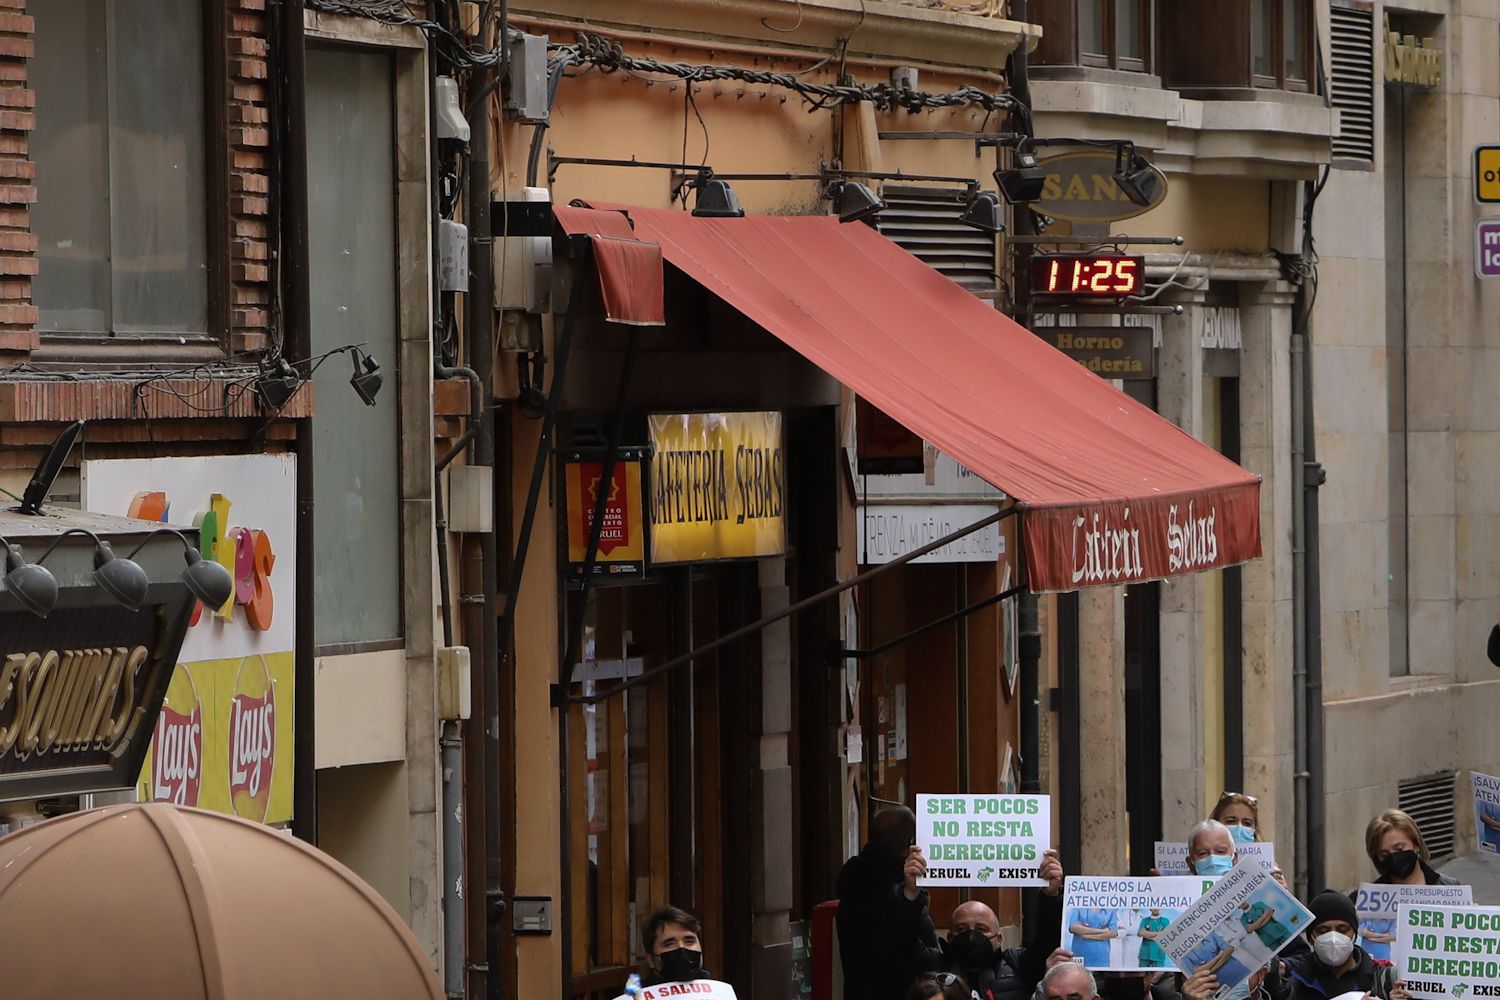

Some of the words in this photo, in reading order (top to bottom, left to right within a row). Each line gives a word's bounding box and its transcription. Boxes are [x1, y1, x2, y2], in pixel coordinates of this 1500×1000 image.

[1049, 260, 1136, 291] 11:25
[1057, 334, 1124, 349] Horno
[736, 445, 782, 524] SEBAS
[232, 691, 272, 798] Lay's
[927, 799, 967, 815] SER
[974, 799, 1039, 815] POCOS
[933, 821, 960, 837] NO
[967, 821, 1033, 837] RESTA
[930, 844, 1036, 861] DERECHOS
[1068, 880, 1133, 893] ¡SALVEMOS
[1138, 880, 1153, 892] LA
[1067, 894, 1128, 907] ATENCIÓN
[1131, 896, 1191, 908] PRIMARIA!
[1357, 891, 1398, 912] 25%
[1400, 887, 1411, 897] DEL
[1412, 887, 1463, 897] PRESUPUESTO
[1408, 909, 1445, 929] SER
[1412, 933, 1437, 951] NO
[658, 982, 712, 998] SALUD
